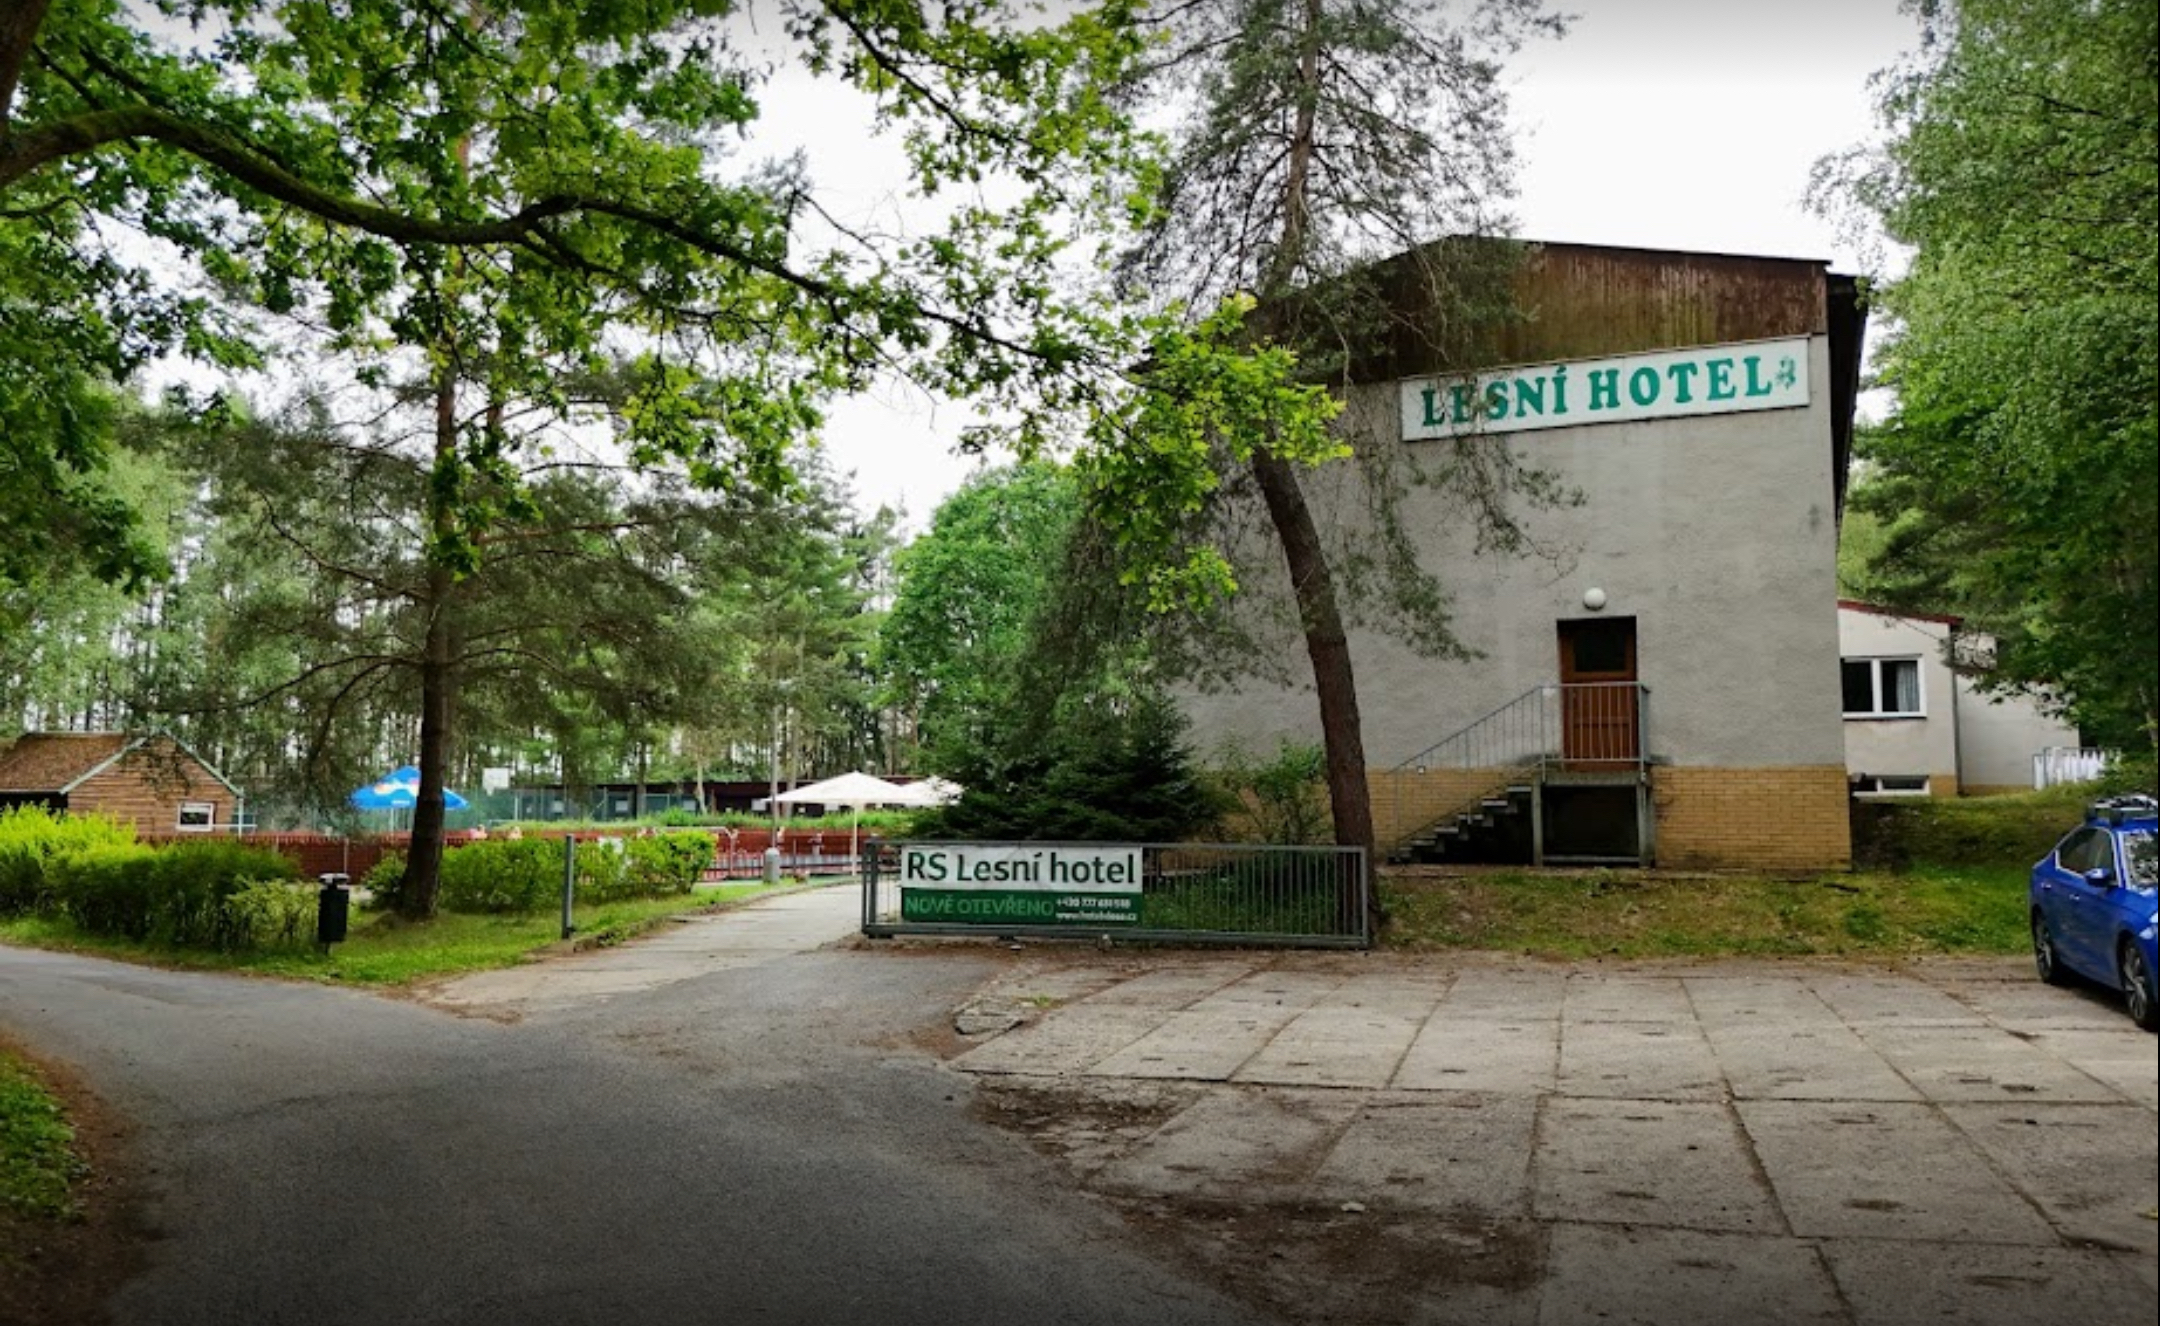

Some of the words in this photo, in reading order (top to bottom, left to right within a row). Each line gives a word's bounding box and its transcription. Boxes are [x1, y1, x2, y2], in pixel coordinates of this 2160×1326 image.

[1420, 363, 1568, 427] LESNÍ
[1587, 355, 1773, 411] HOTEL
[907, 851, 947, 881] RS
[956, 852, 1042, 882] Lesní
[1050, 851, 1135, 884] hotel
[957, 894, 1054, 916] OTEVŘENO
